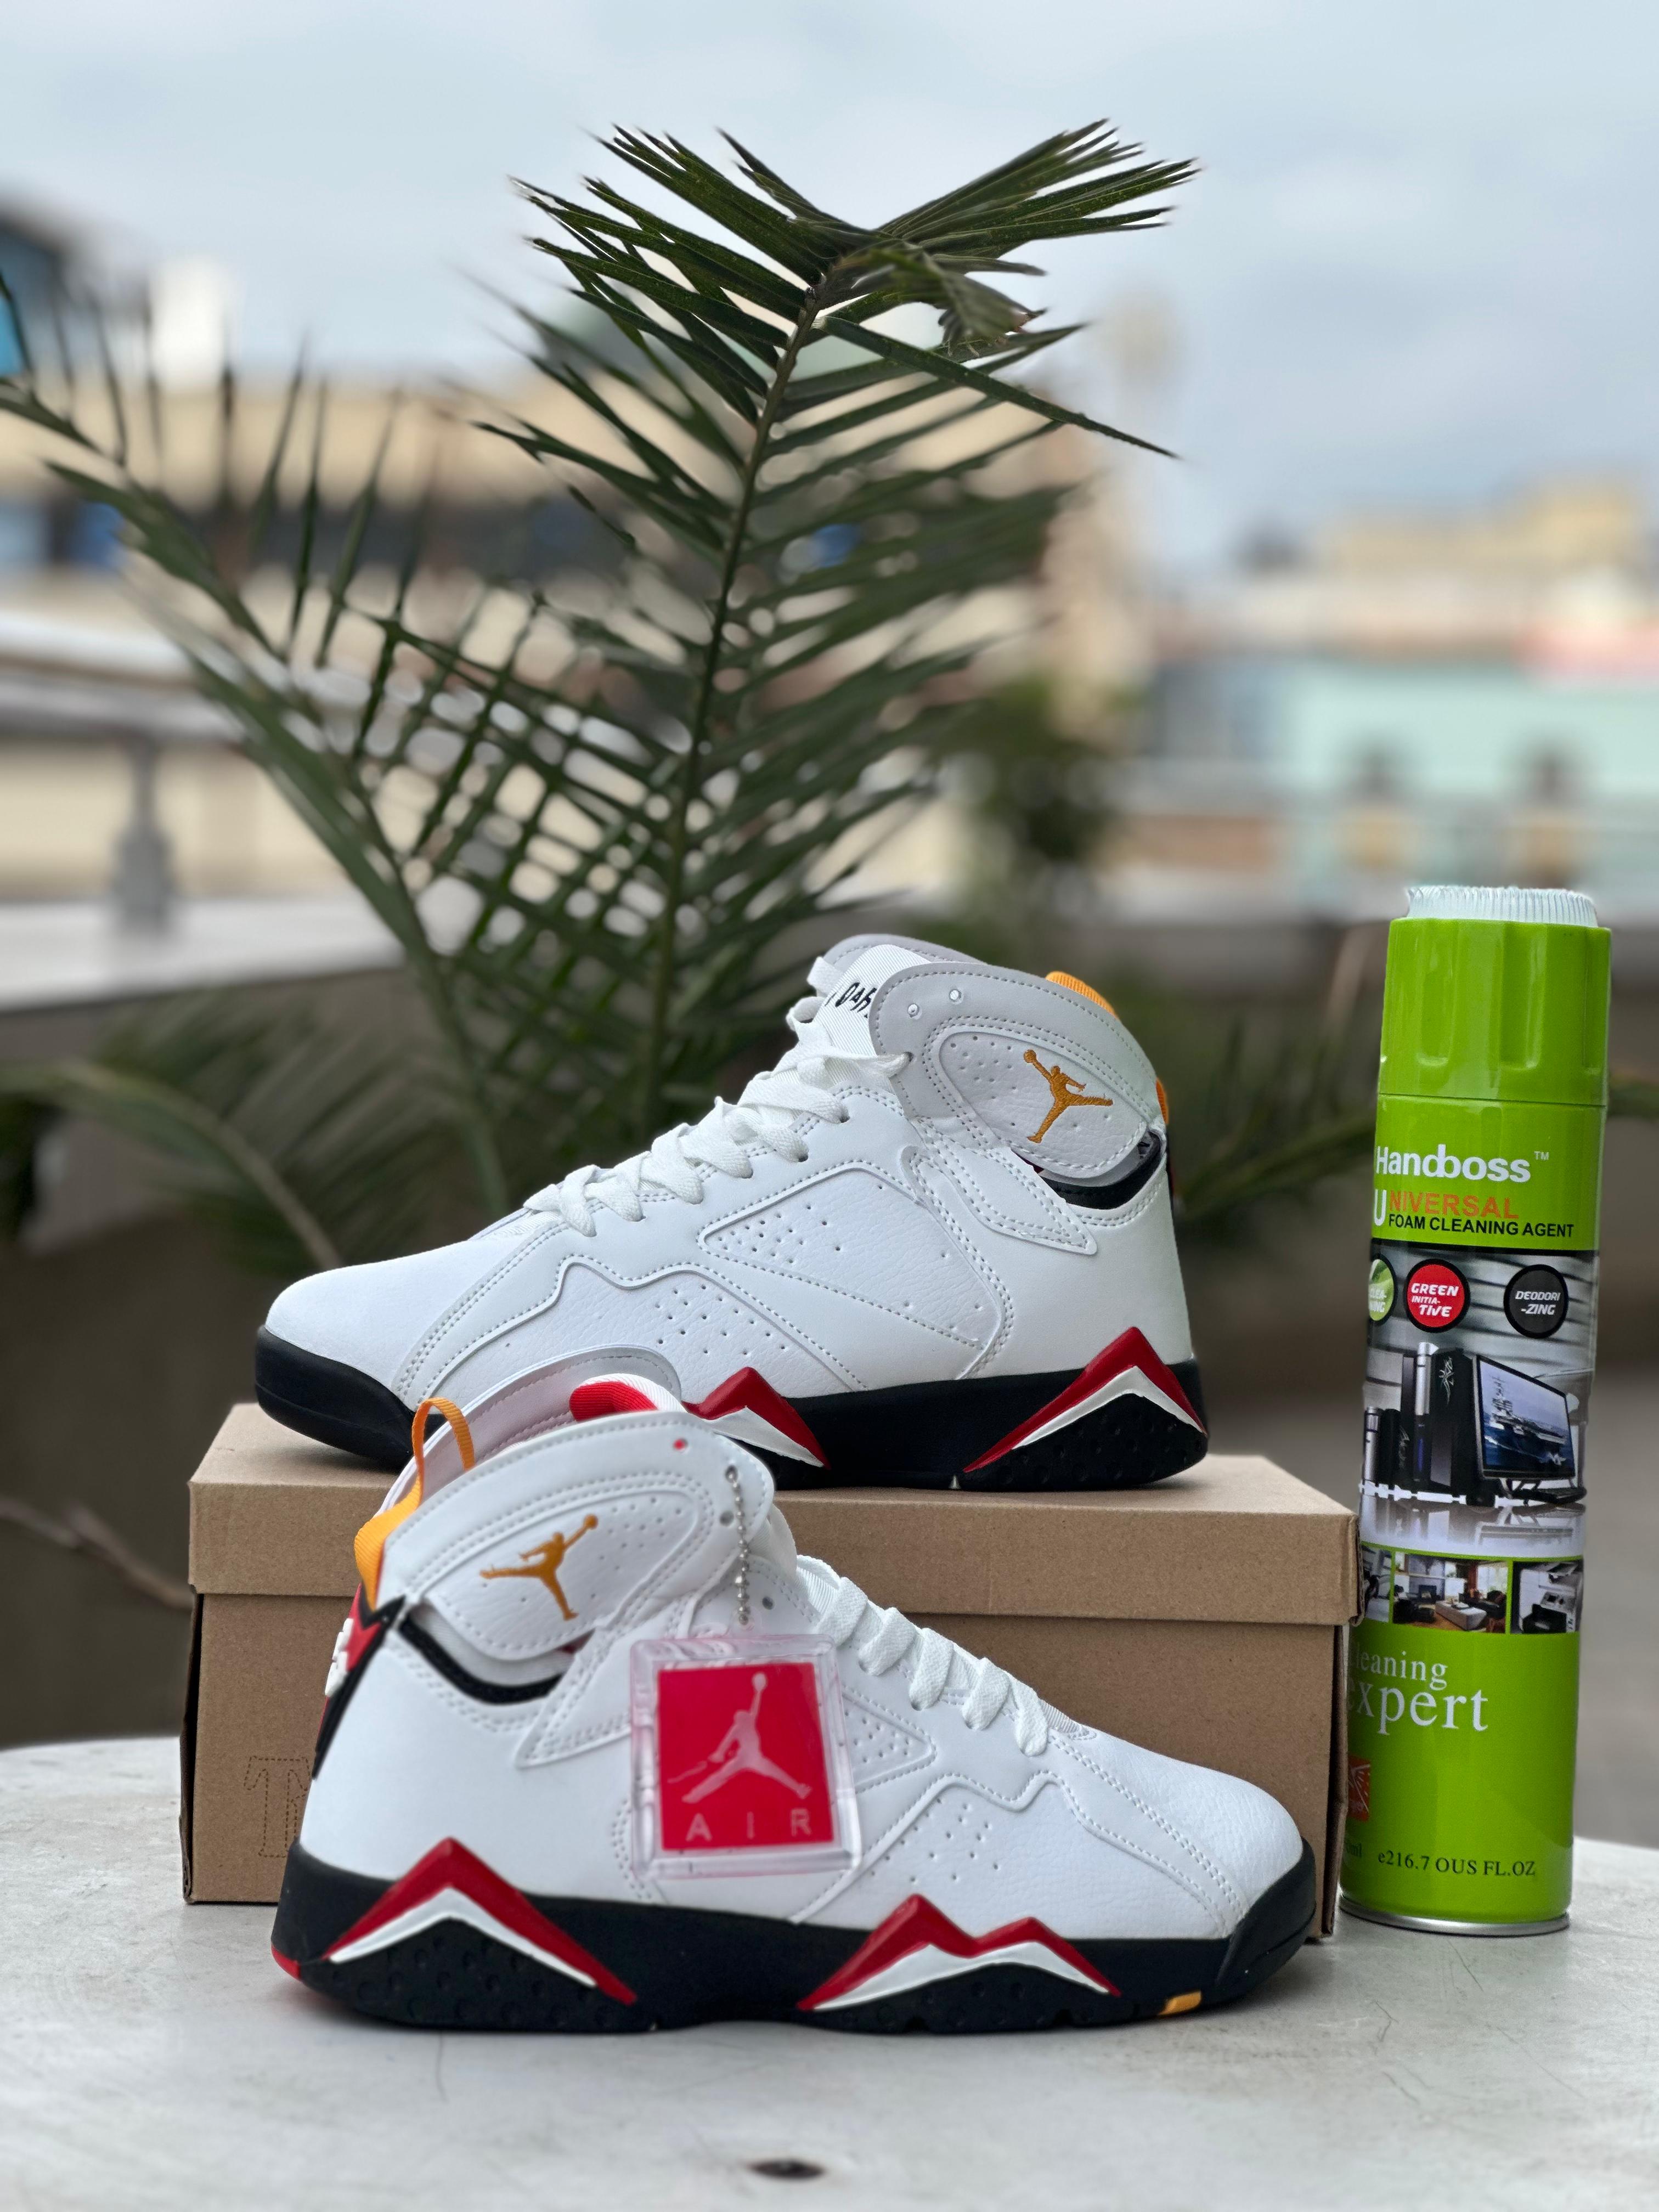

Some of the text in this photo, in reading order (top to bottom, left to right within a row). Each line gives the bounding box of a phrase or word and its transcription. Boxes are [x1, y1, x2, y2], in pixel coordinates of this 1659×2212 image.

[1375, 1144, 1531, 1183] Handboss
[1389, 1214, 1574, 1237] FOAM CLEANING AGENT
[1411, 1283, 1459, 1296] GREEN
[1515, 1290, 1561, 1301] DEODORI
[1411, 1295, 1441, 1305] INITIA-
[1419, 1304, 1453, 1317] TIVE
[1521, 1304, 1556, 1315] -ZING
[1351, 1644, 1448, 1691] leaning
[685, 1808, 812, 1842] AIR
[1483, 1860, 1536, 1876] FL.OZ
